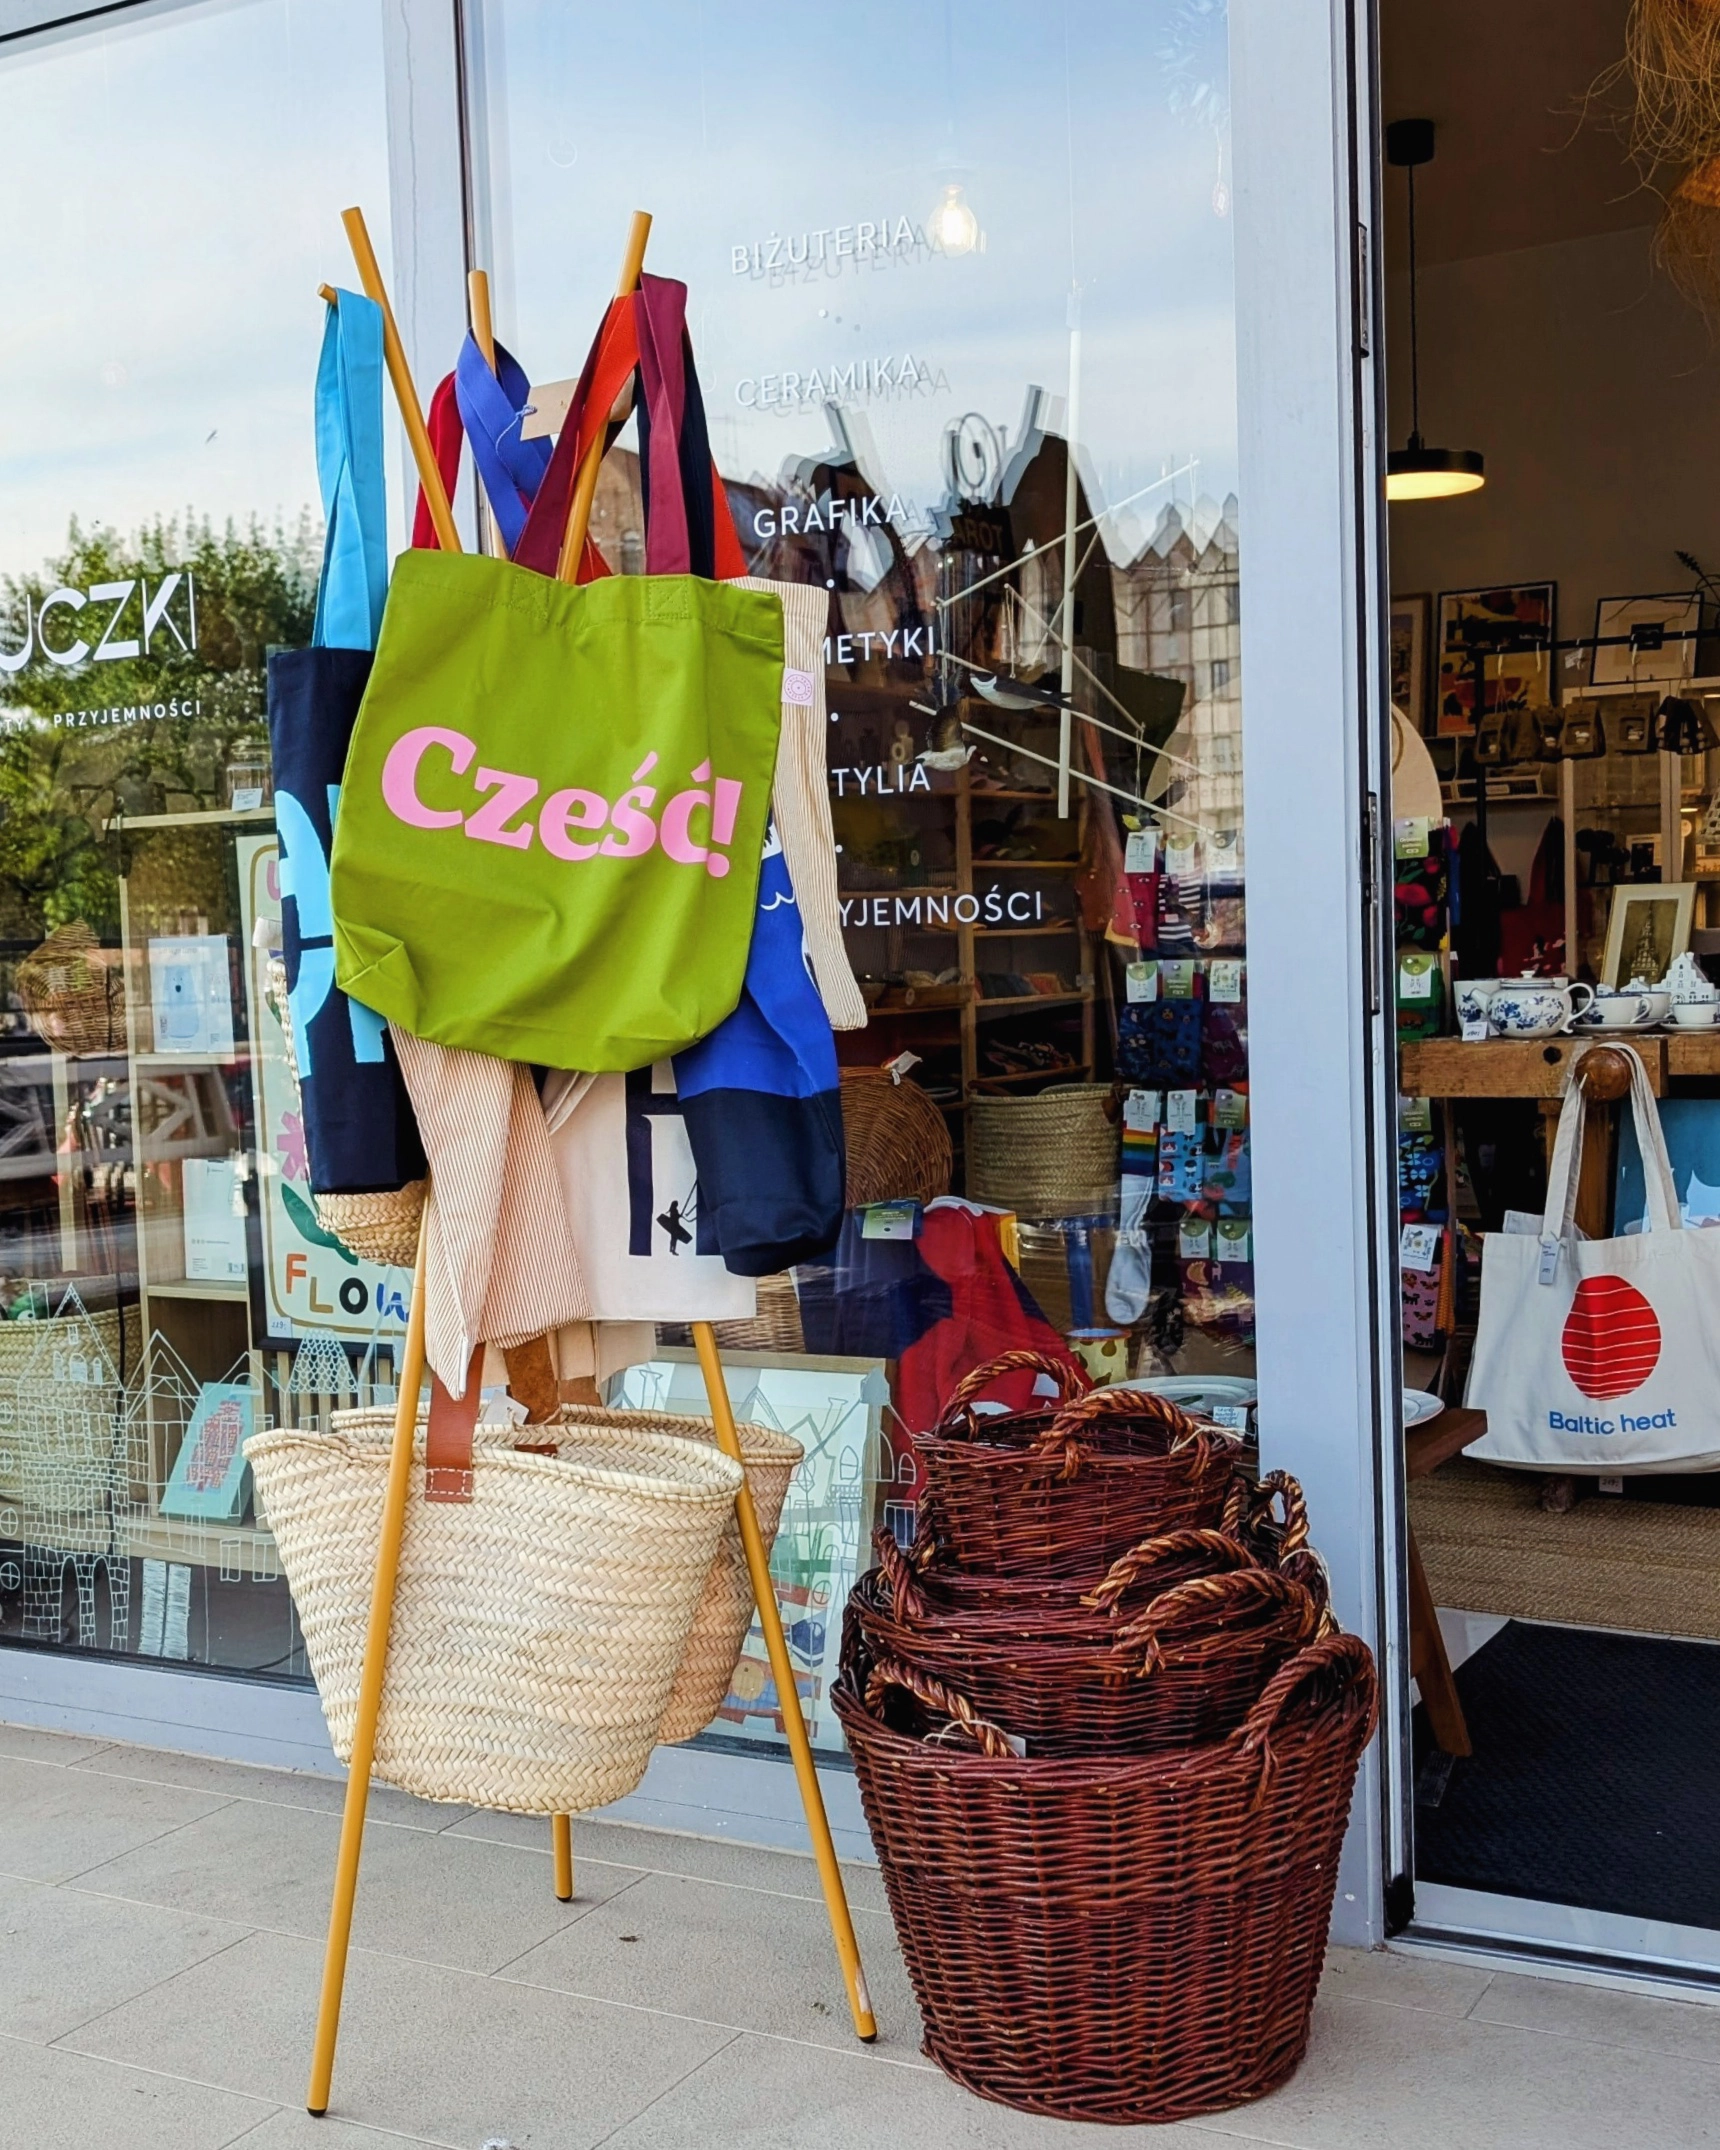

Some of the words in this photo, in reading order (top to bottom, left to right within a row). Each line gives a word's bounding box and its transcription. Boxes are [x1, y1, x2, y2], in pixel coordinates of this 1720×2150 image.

[731, 215, 916, 275] BIŻUTERIA
[735, 353, 920, 407] CERAMIKA
[753, 493, 907, 538] GRAFIKA
[53, 698, 200, 728] PRZYJEMNOŚCI
[831, 763, 931, 796] TYLIA
[381, 726, 743, 878] Cześć!
[838, 884, 1042, 927] YJEMNOŚCI
[1549, 1410, 1615, 1435] Baltic
[1620, 1408, 1677, 1433] heat
